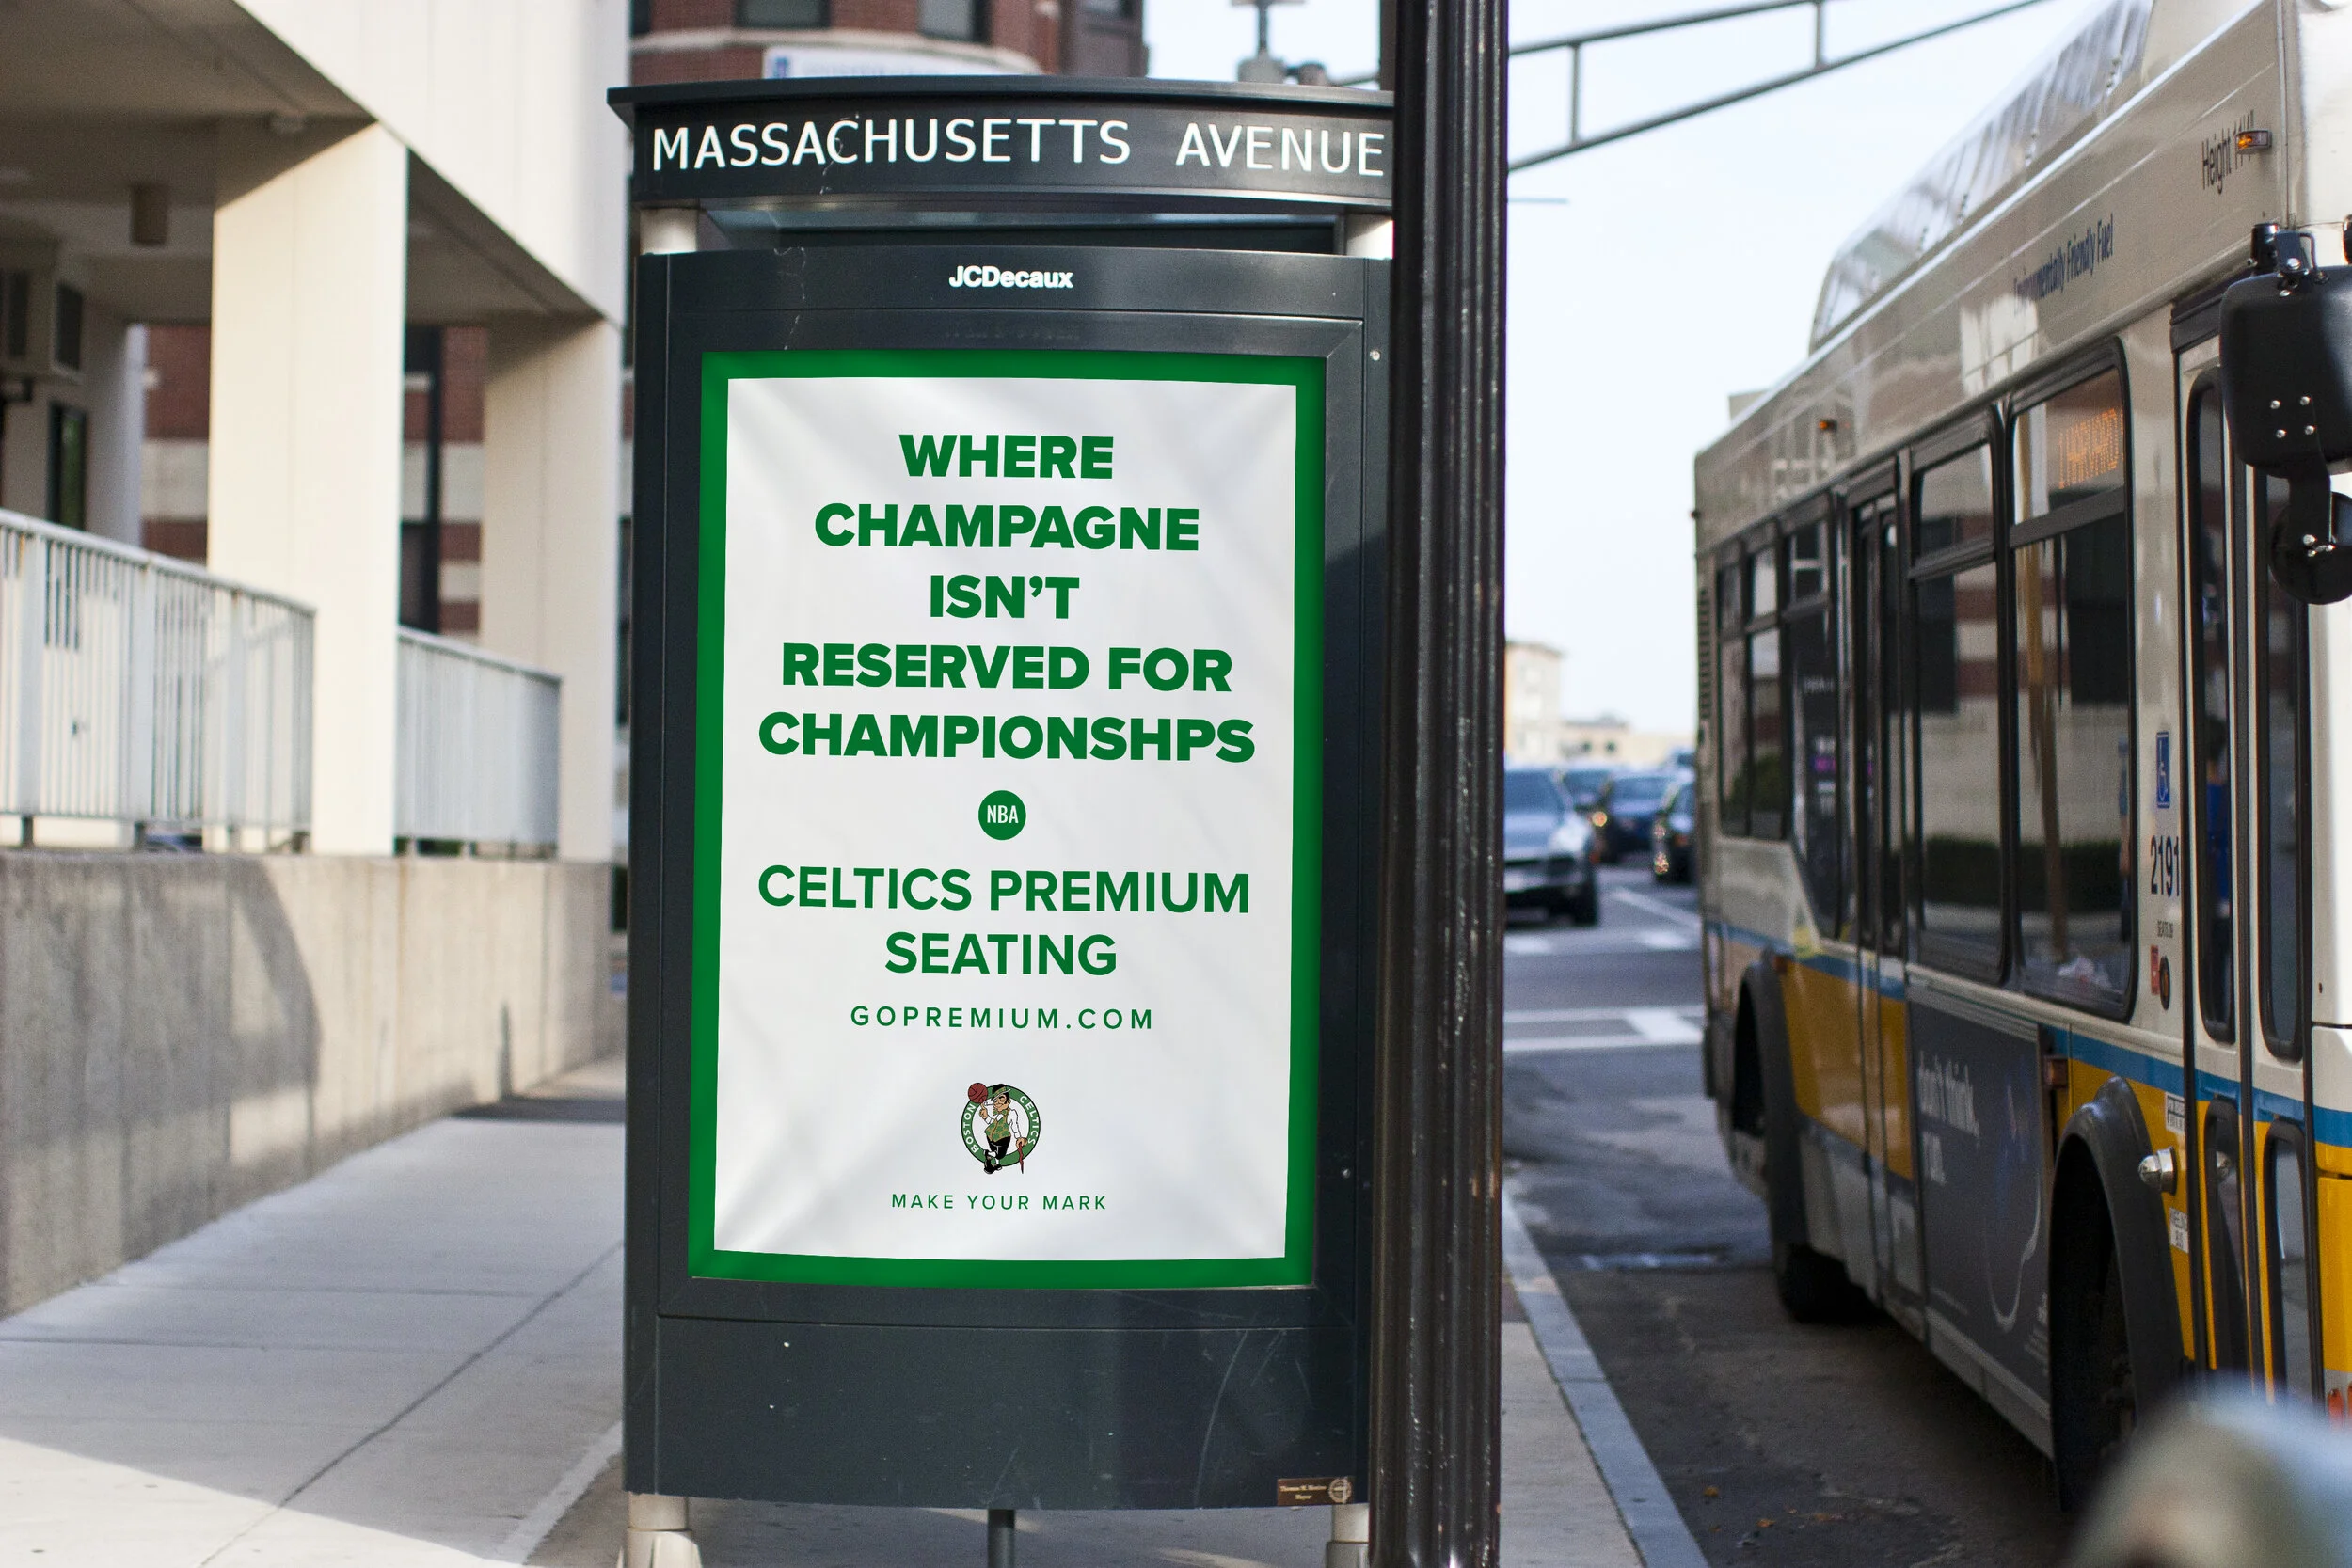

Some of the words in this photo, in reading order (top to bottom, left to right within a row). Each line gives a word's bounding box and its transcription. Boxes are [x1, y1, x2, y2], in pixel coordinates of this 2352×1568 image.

[653, 117, 1131, 171] MASSACHUSETTS
[1176, 122, 1386, 178] AVENUE
[2201, 127, 2232, 195] Height
[2097, 213, 2114, 263] Fuel
[949, 266, 1074, 290] JCDecaux
[899, 435, 1114, 480] WHERE
[815, 503, 1200, 551] CHAMPAGNE
[930, 575, 1080, 620] ISN’T
[783, 643, 1090, 689] RESERVED
[1109, 647, 1232, 692] FOR
[759, 712, 1256, 764] CHAMPIONSHPS
[987, 804, 1019, 824] NBA
[759, 865, 973, 911] CELTICS
[991, 870, 1250, 914] PREMIUM
[2150, 834, 2180, 897] 2191
[885, 932, 1118, 976] SEATING
[850, 1006, 1153, 1030] GOPREMIUM.COM
[962, 1102, 979, 1154] BOSTON
[1019, 1095, 1040, 1145] CELTICS
[892, 1194, 954, 1210] MAKE
[967, 1195, 1030, 1211] YOUR
[1042, 1196, 1107, 1211] MARK
